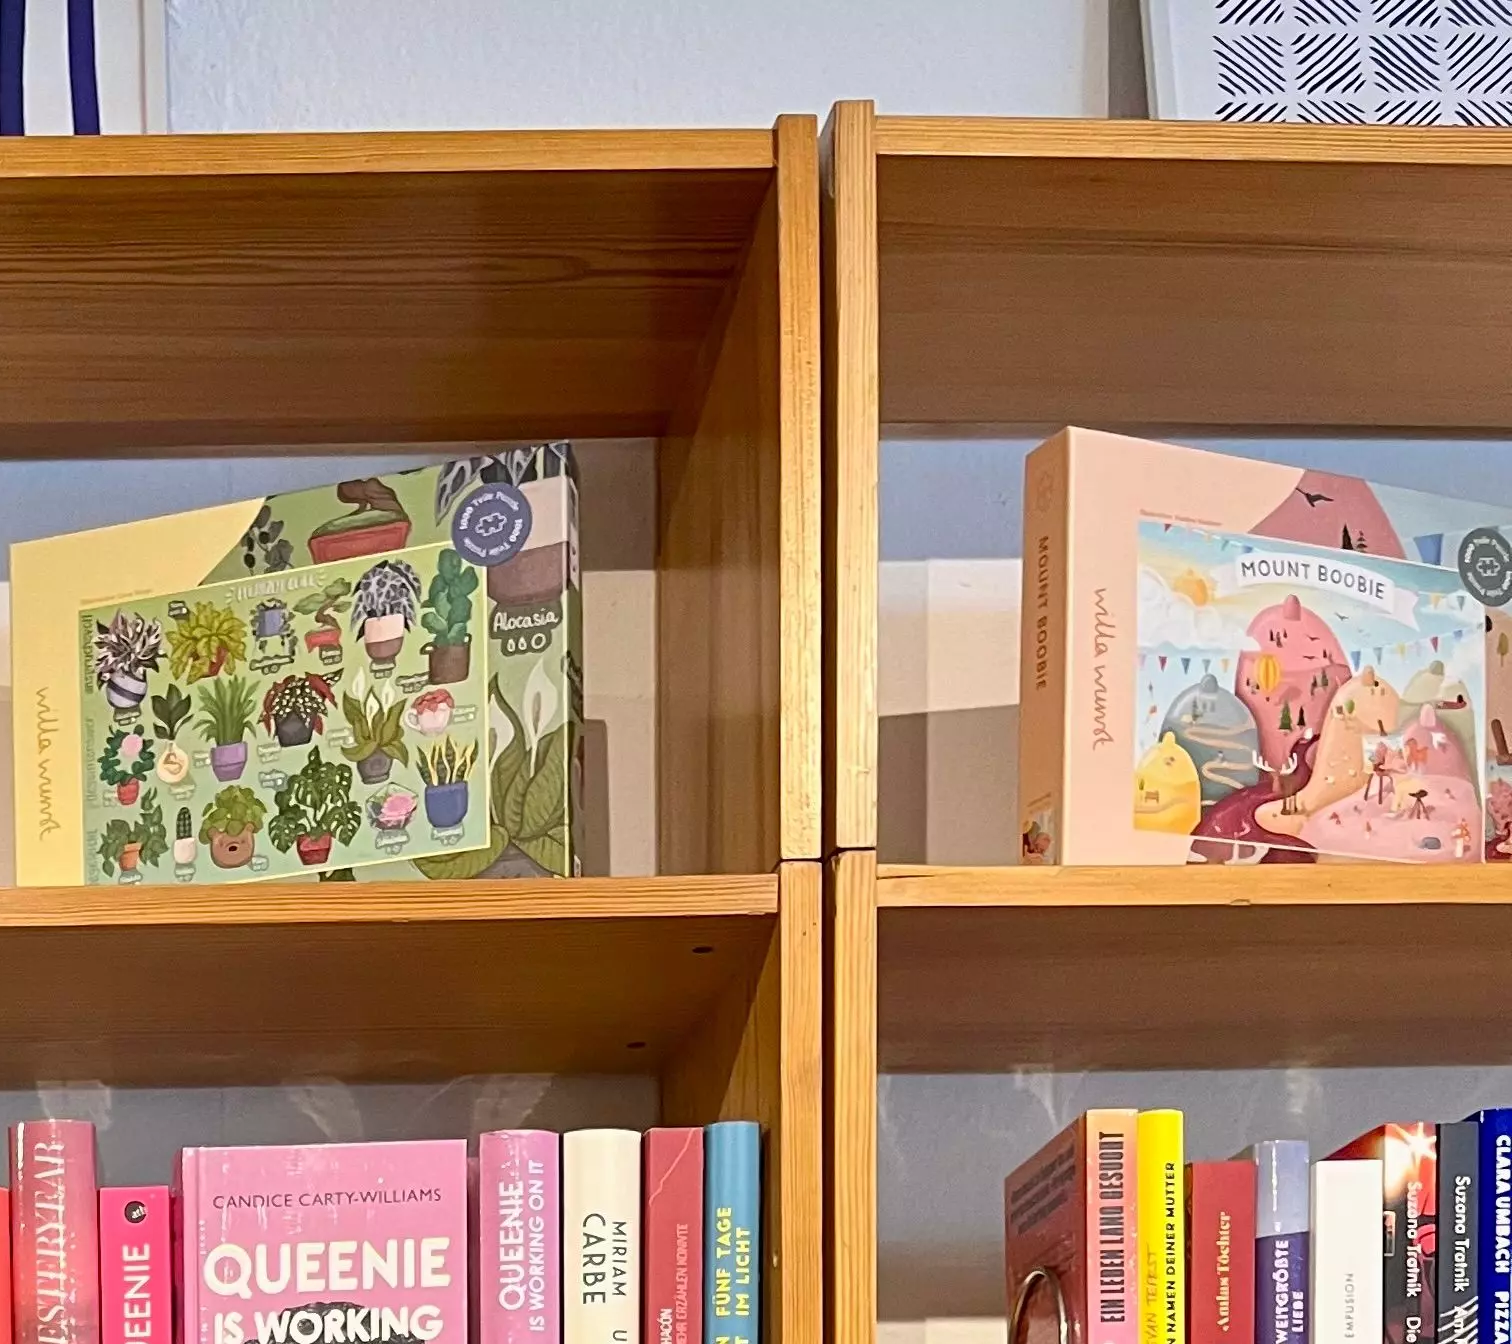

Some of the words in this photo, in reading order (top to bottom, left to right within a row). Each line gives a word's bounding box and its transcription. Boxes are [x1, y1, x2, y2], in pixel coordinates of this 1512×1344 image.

[1240, 560, 1310, 580] MOUNT
[1317, 565, 1386, 600] BOOBIE
[493, 608, 560, 633] Alocasia
[1164, 1162, 1176, 1211] MUTTER
[1495, 1134, 1512, 1195] CLARA
[213, 1194, 293, 1209] CANDICE
[299, 1188, 442, 1207] CARTY-WILLIAMS
[1454, 1175, 1471, 1235] Suzana
[499, 1179, 524, 1311] QUEENIE
[583, 1212, 607, 1305] CARBE
[611, 1220, 627, 1297] MIRIAM
[715, 1207, 733, 1263] TAGE
[734, 1227, 750, 1291] LICHT
[1165, 1216, 1176, 1276] DEINER
[1494, 1196, 1511, 1274] UMBACH
[203, 1238, 451, 1298] QUEENIE
[715, 1267, 731, 1317] FÜNF
[1453, 1237, 1470, 1293] Tratnik
[734, 1296, 750, 1316] IM
[1165, 1279, 1177, 1334] NAMEN
[1494, 1291, 1510, 1344] PIZZA
